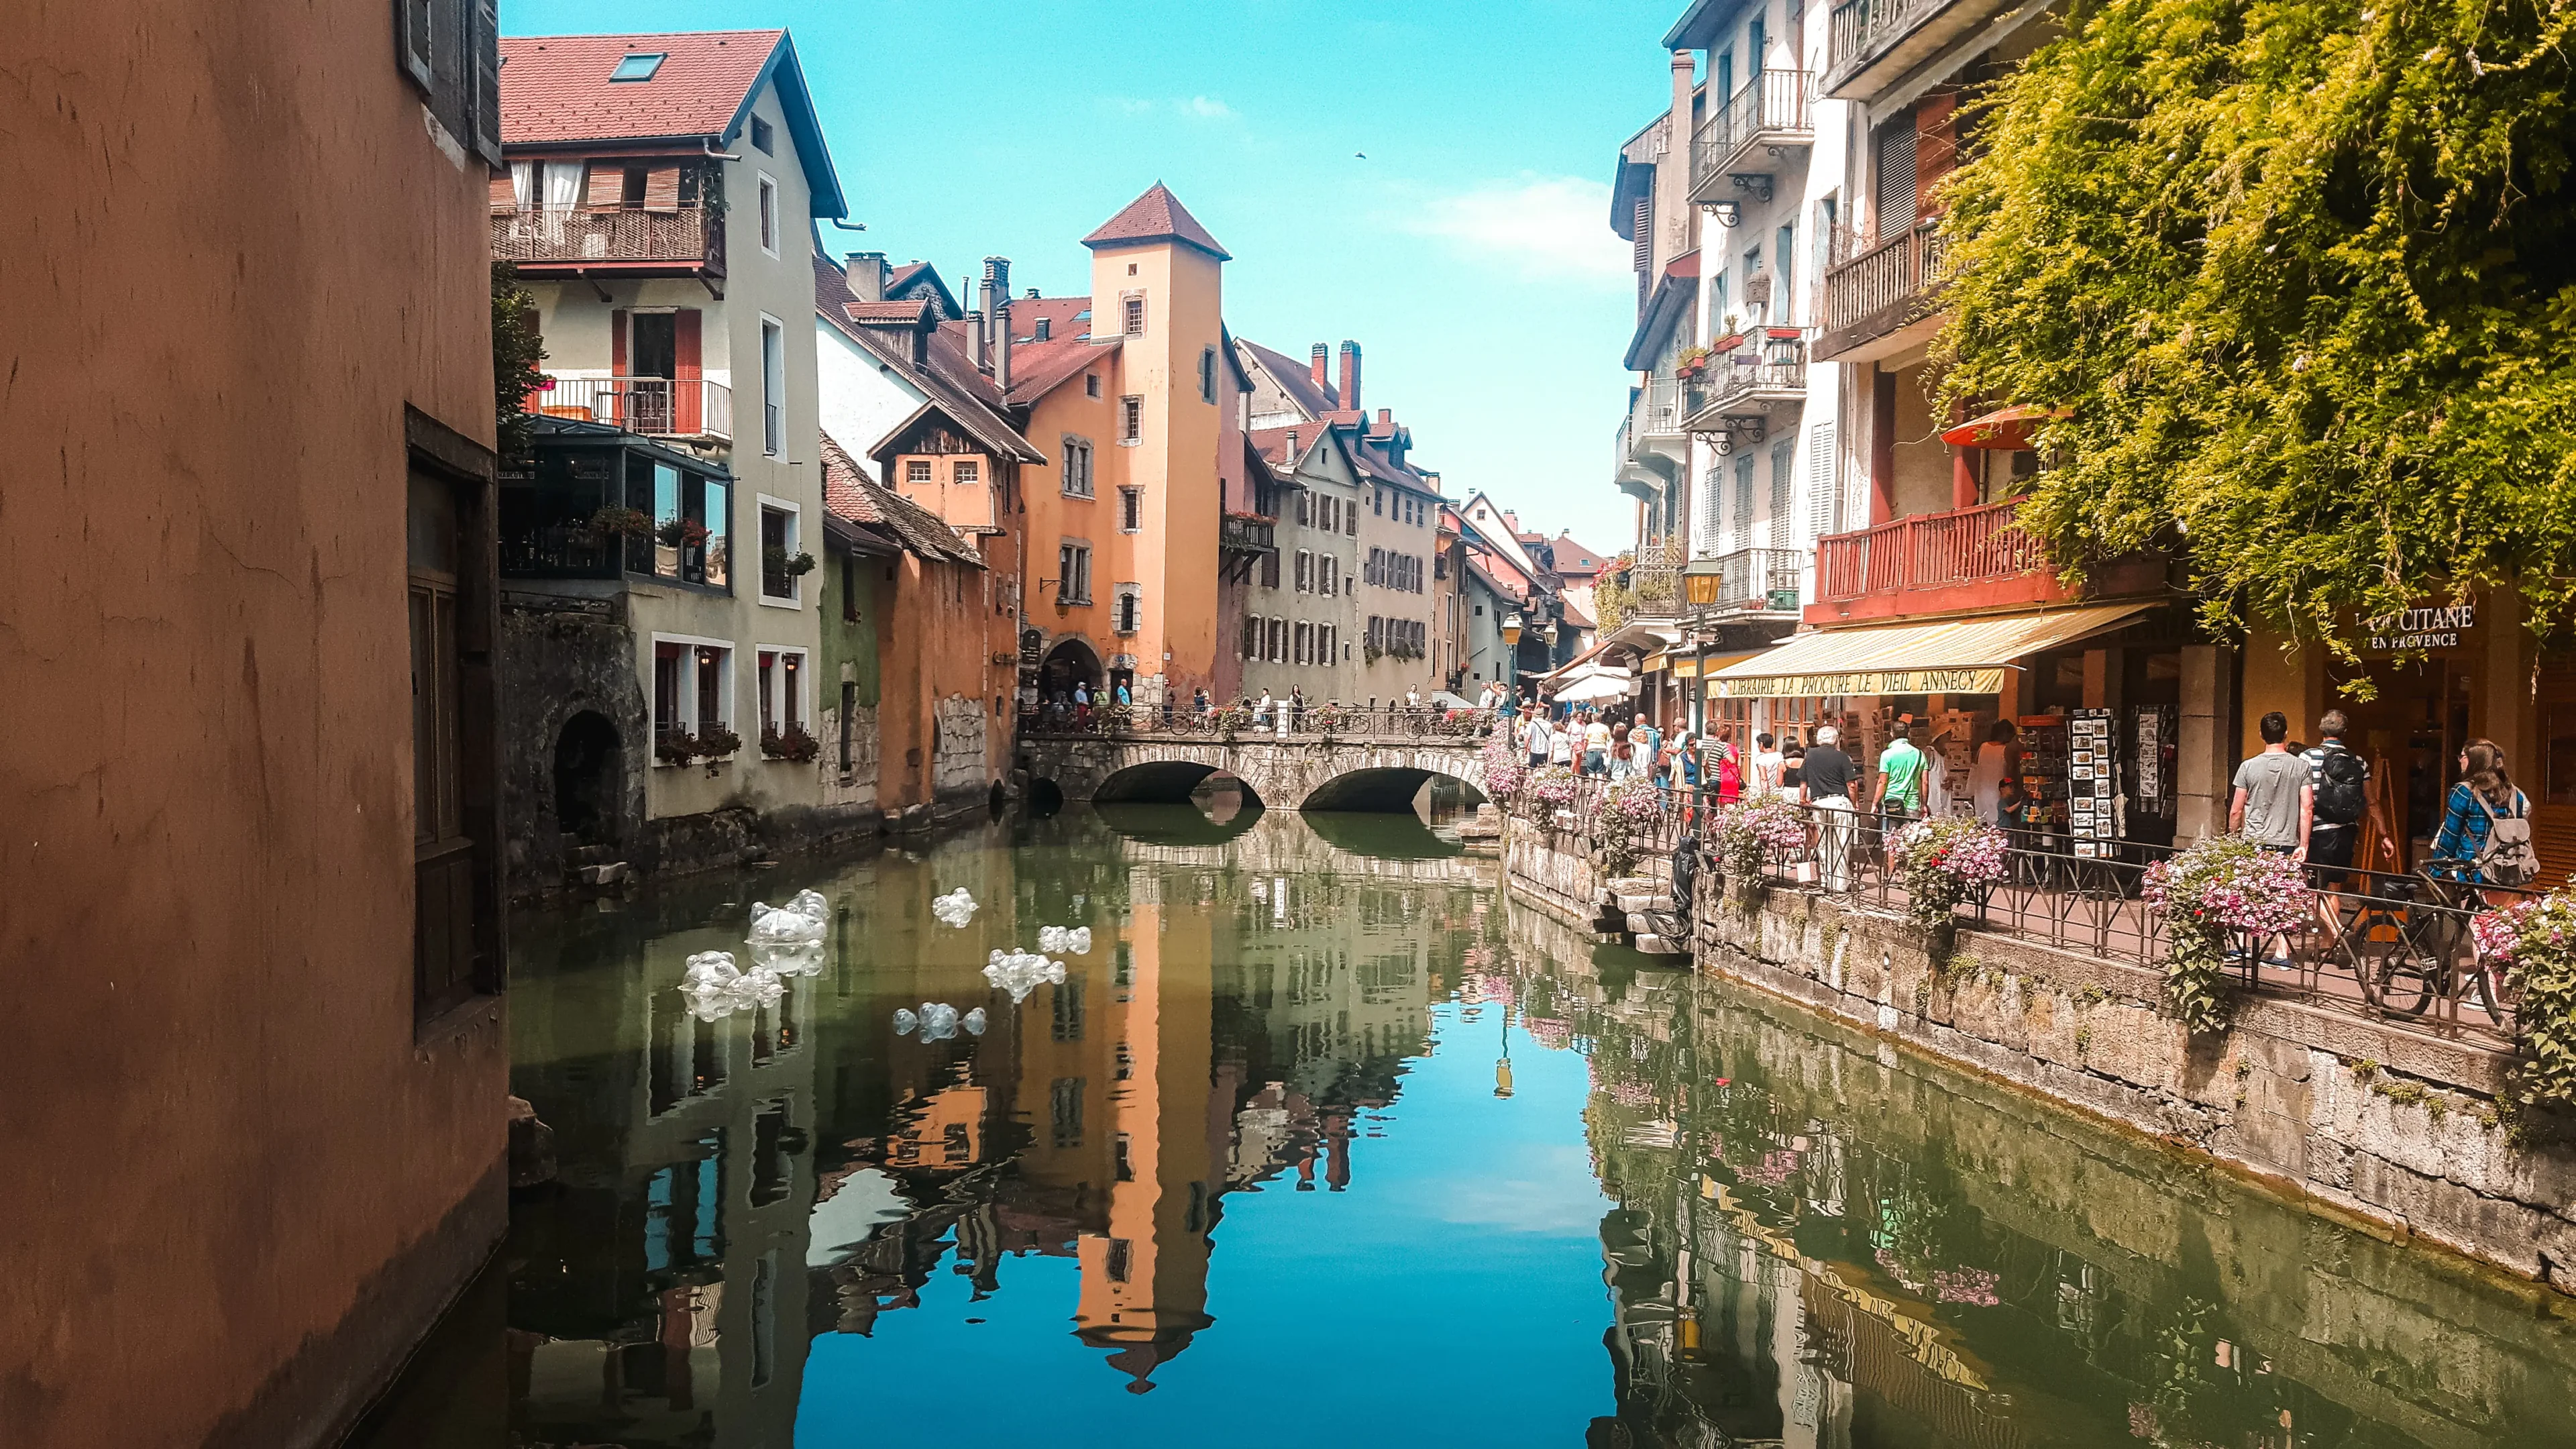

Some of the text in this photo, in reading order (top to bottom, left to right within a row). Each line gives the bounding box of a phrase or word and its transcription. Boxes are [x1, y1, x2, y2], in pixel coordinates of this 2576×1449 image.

[2372, 637, 2386, 649] EN
[1732, 670, 1977, 695] LIBRAIRIE LA PROCURE LE VIEIL ANNECY
